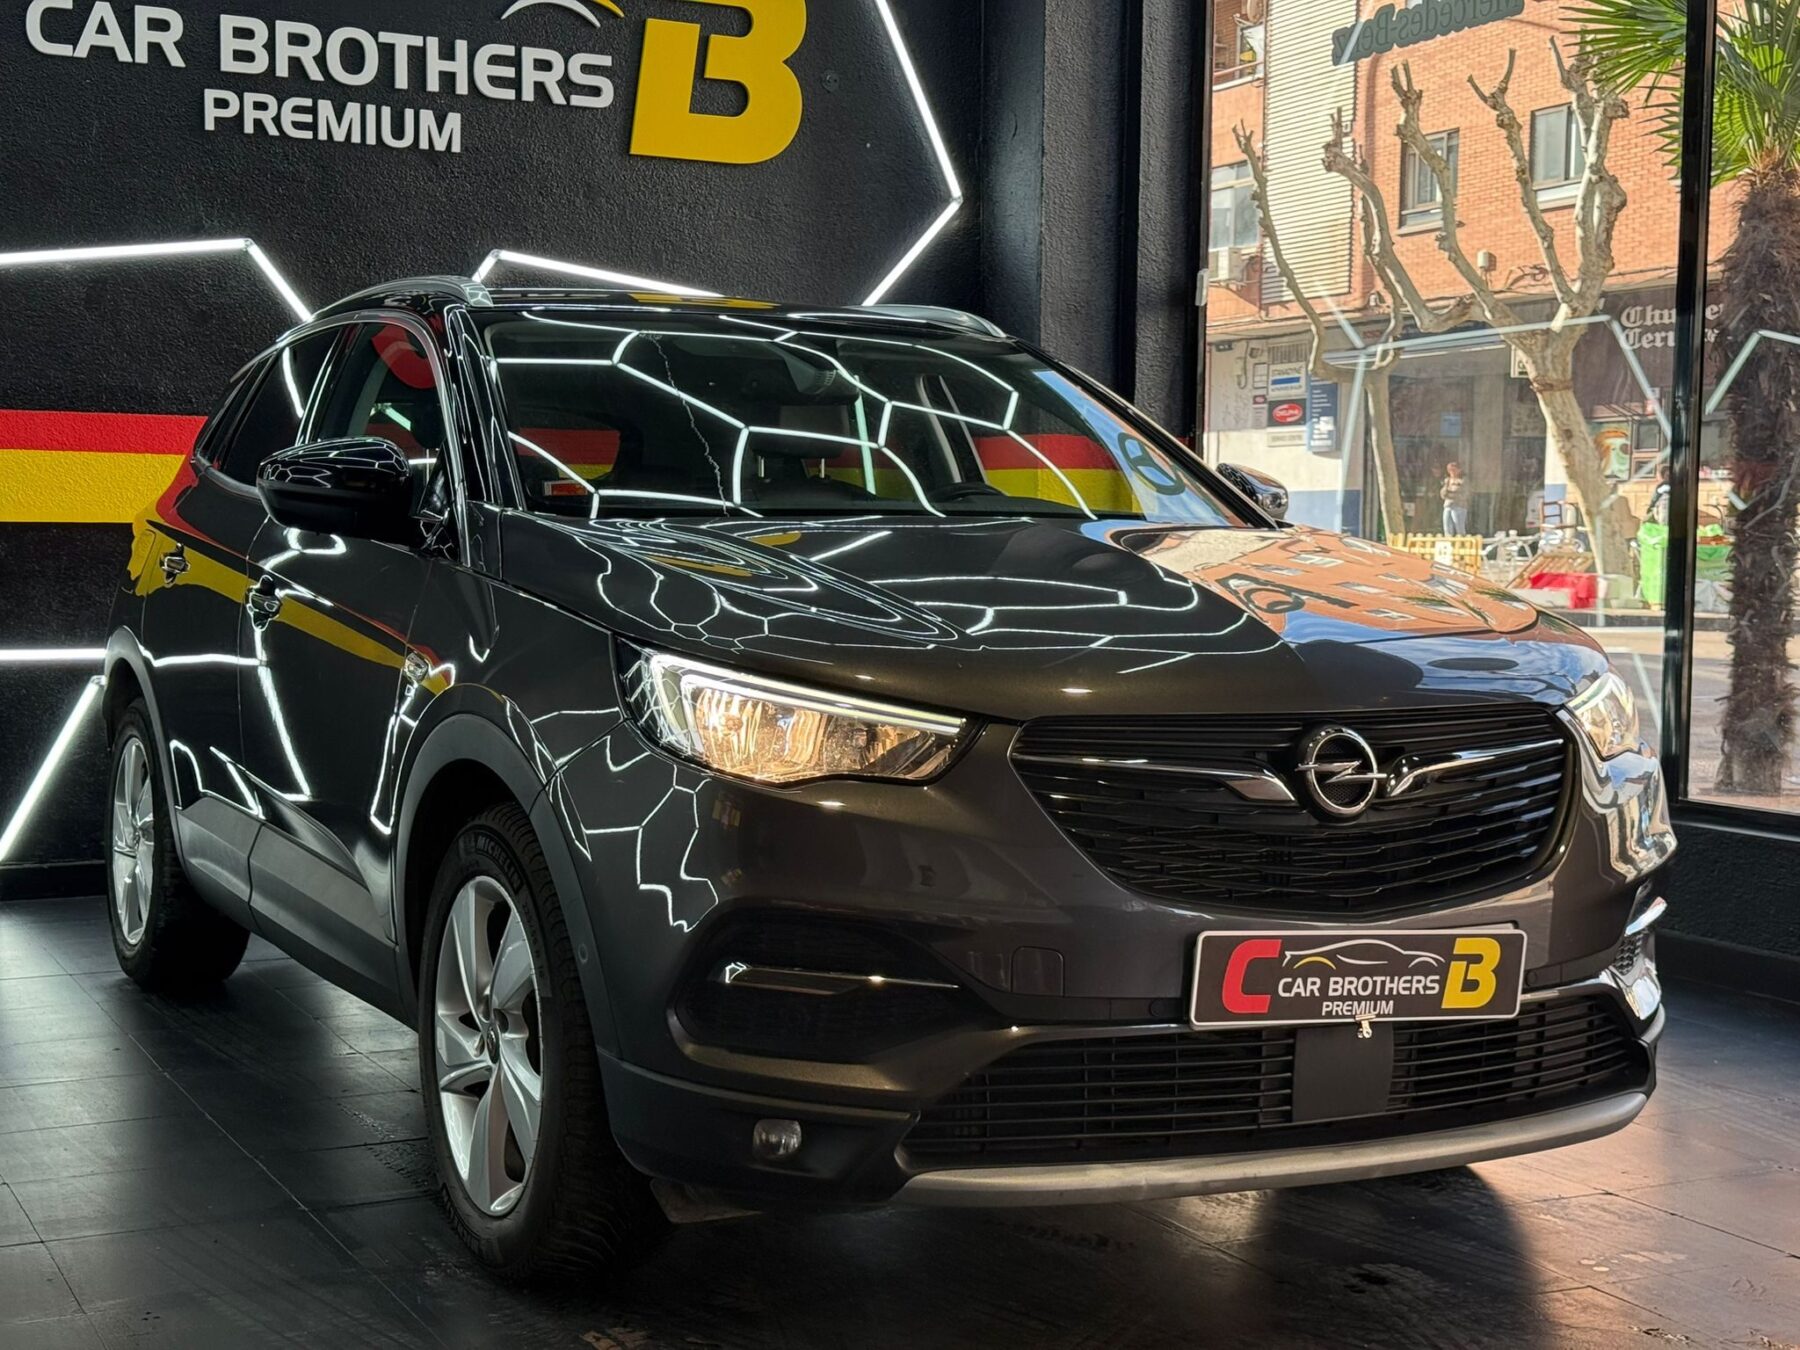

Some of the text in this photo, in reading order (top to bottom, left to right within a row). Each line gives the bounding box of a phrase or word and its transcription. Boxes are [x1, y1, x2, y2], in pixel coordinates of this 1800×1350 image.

[25, 0, 615, 109] CAR BROTHERS
[203, 88, 462, 153] PREMIUM
[1222, 939, 1283, 1014] C
[1277, 975, 1441, 998] CAR BROTHERS
[1441, 937, 1501, 1009] B
[1321, 1000, 1394, 1017] PREMIUM
